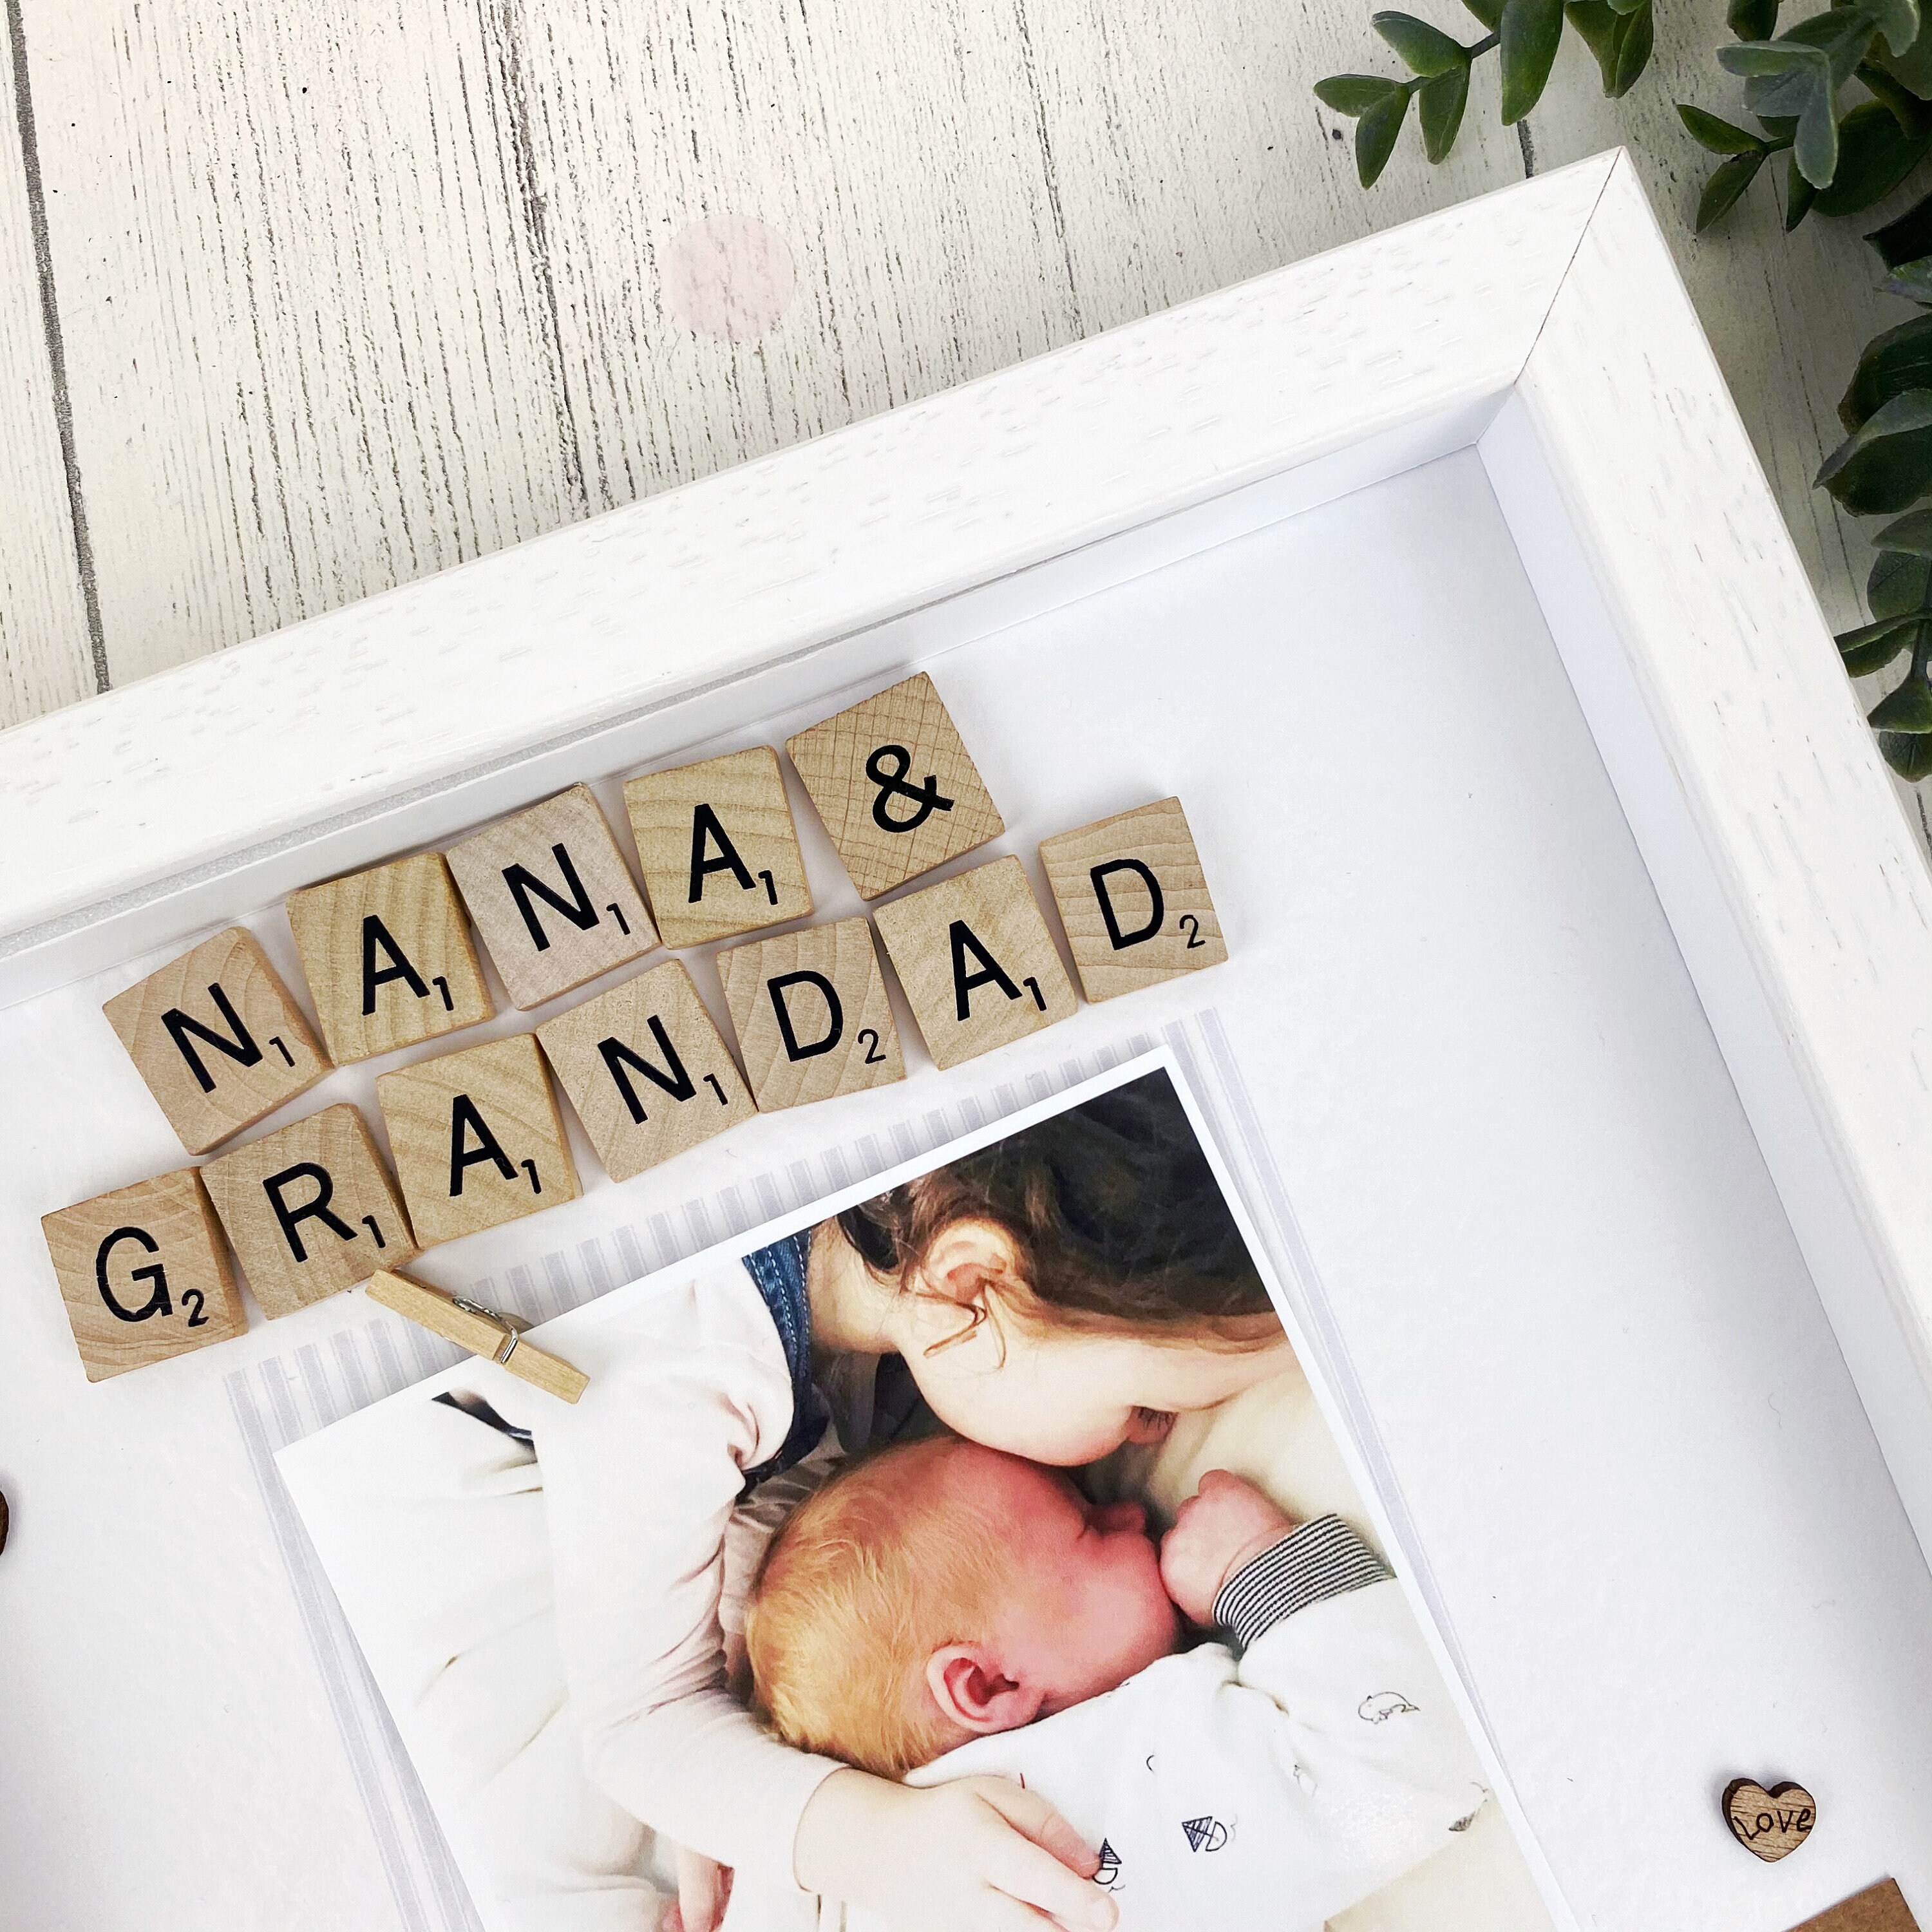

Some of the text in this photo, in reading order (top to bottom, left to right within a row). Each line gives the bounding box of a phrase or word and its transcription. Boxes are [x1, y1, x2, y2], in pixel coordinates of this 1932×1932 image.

[95, 858, 1164, 1322] GRANDAD
[161, 744, 955, 1094] NANA &
[1734, 1808, 1813, 1841] Love
